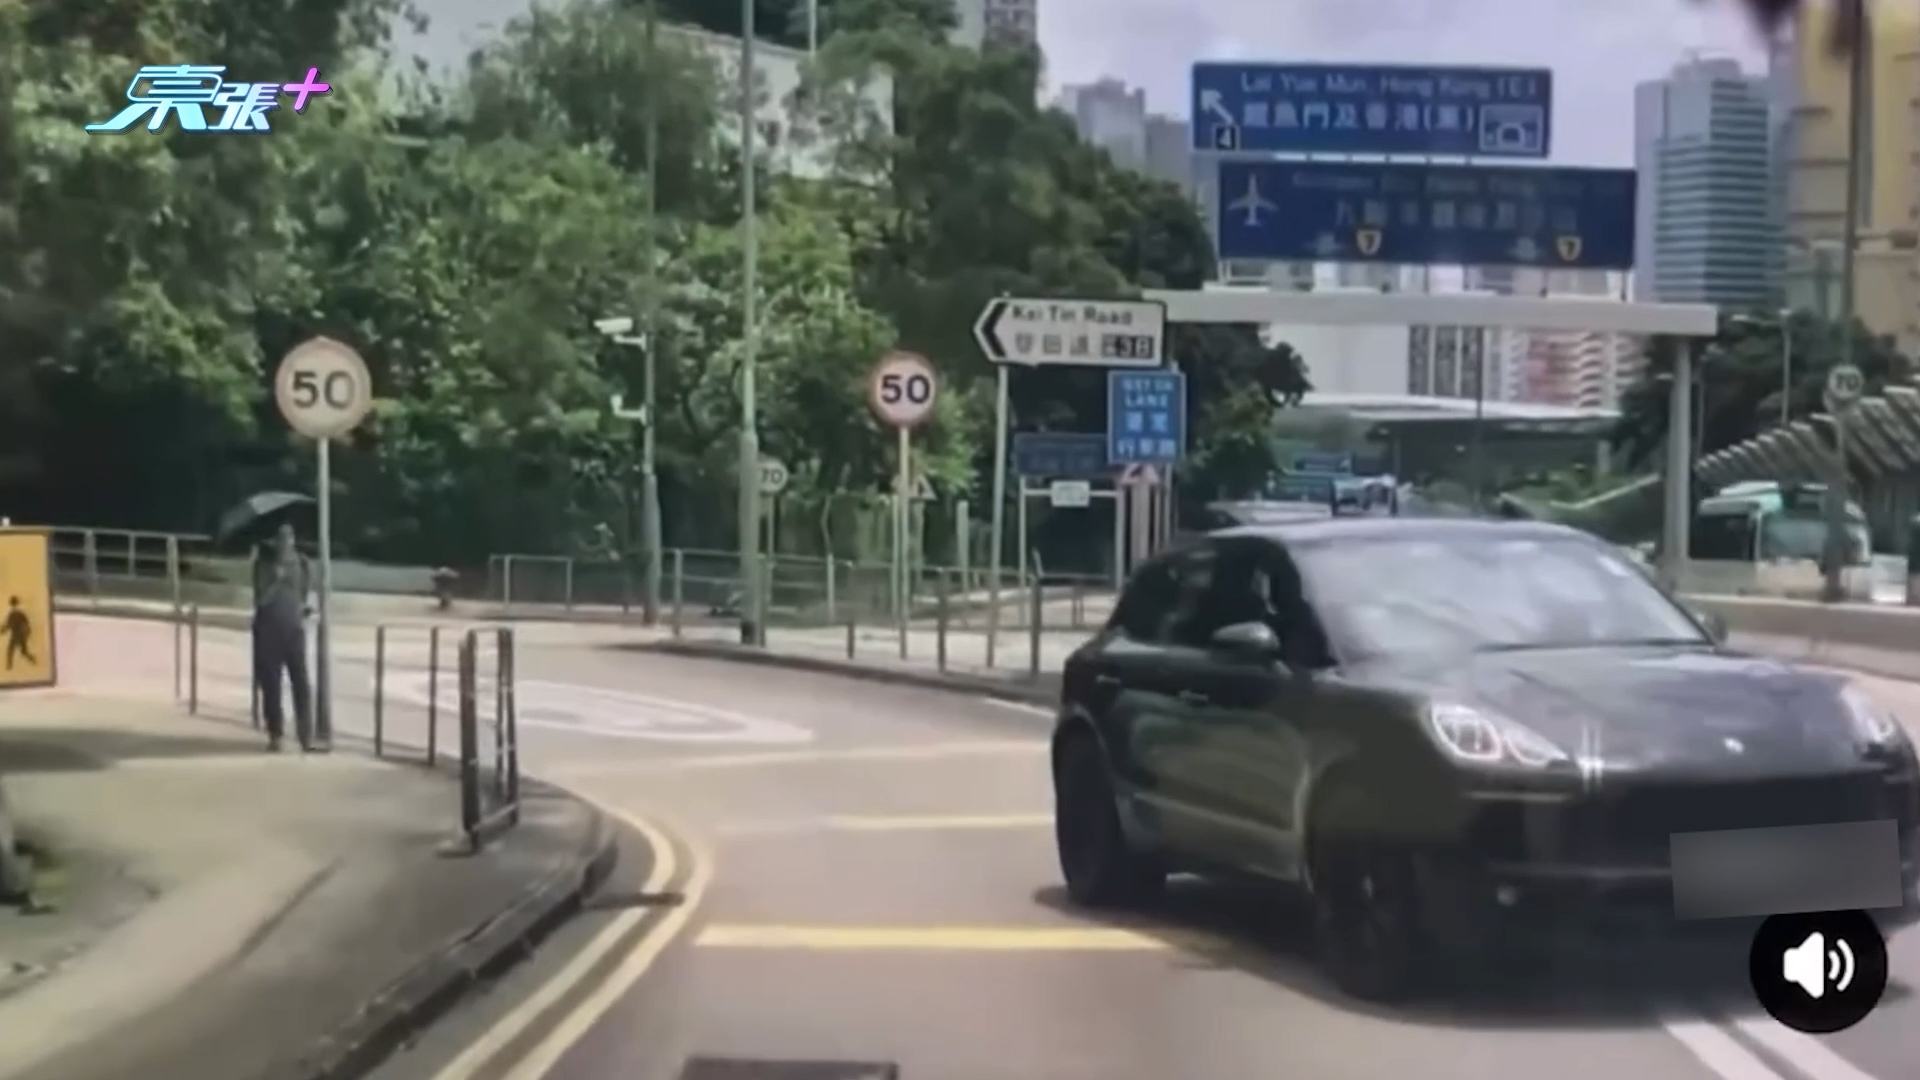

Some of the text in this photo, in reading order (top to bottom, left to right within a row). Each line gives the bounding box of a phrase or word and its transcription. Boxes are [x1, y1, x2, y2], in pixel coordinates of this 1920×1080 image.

[1083, 305, 1134, 326] Road
[292, 371, 356, 410] 50
[881, 374, 931, 404] 50
[1835, 373, 1858, 390] 70
[760, 469, 784, 485] 70
